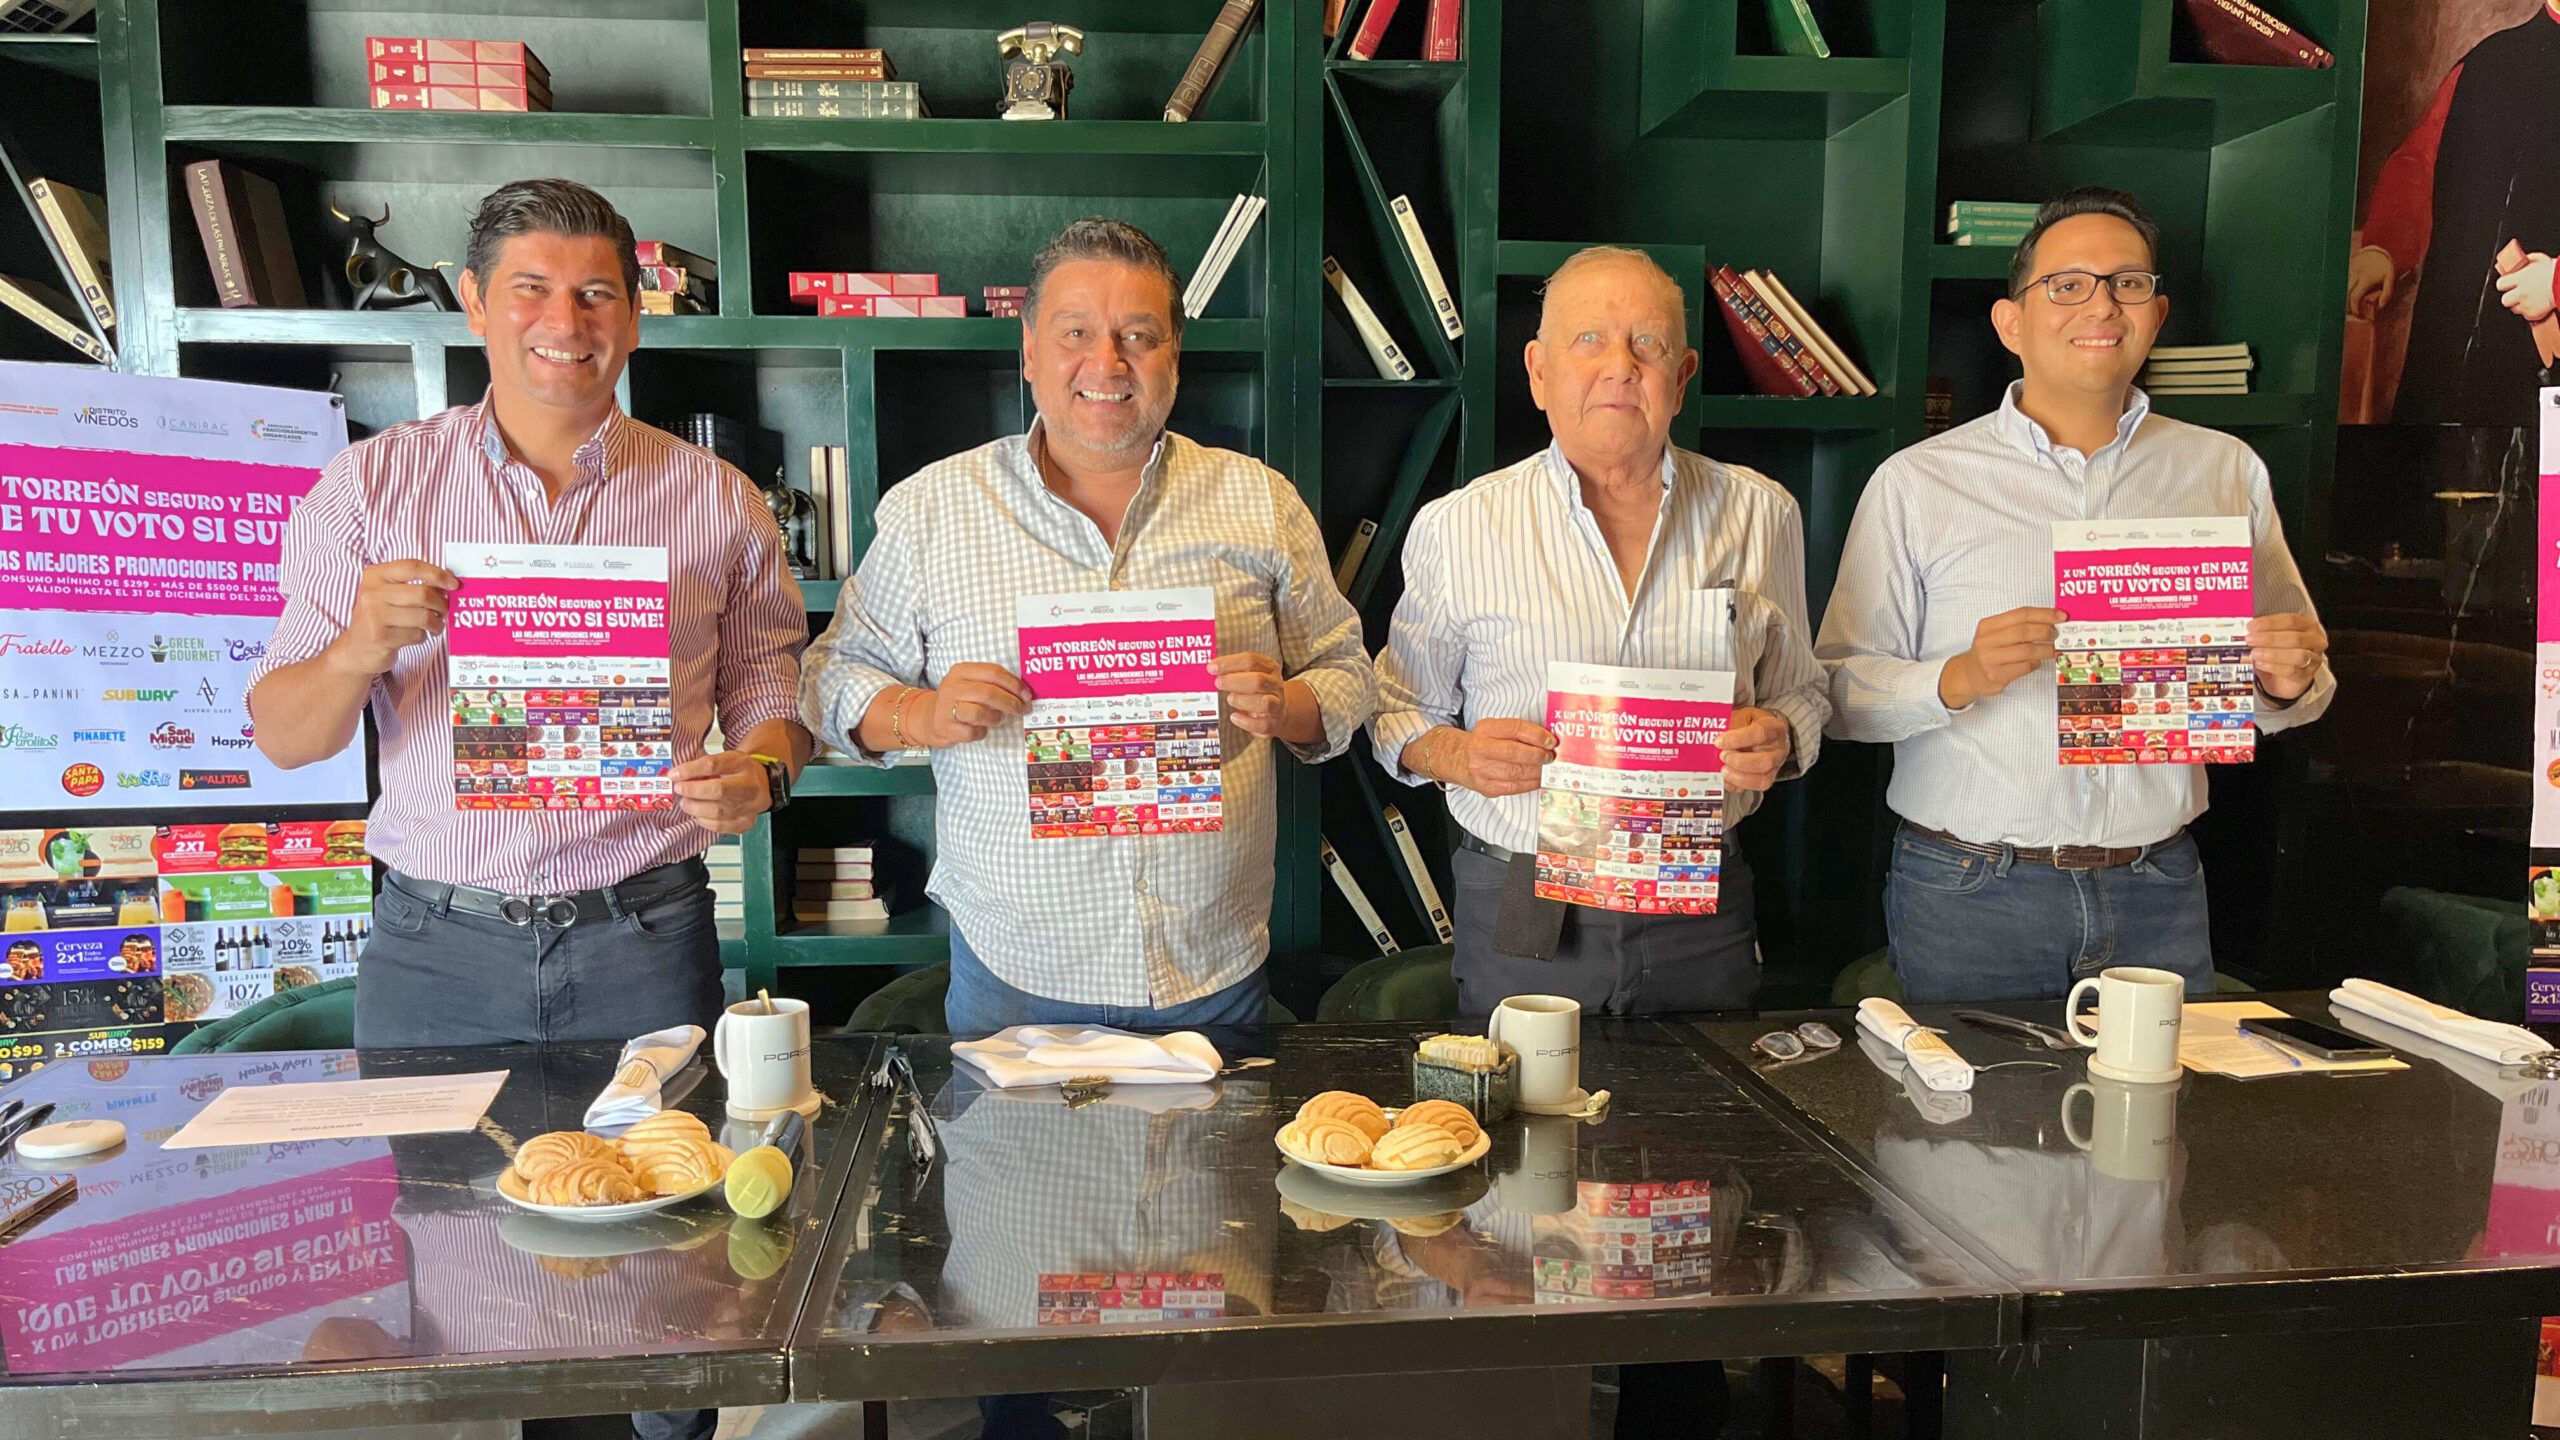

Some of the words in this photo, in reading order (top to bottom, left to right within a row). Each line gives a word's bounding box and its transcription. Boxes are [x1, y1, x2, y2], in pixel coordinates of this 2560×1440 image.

[813, 279, 827, 288] 2
[2, 475, 140, 506] TORREÓN
[144, 490, 225, 512] SEGURO
[228, 496, 243, 513] Y
[246, 492, 283, 515] EN
[31, 505, 81, 535] TU
[88, 509, 185, 541] VOTO
[192, 516, 228, 544] SI
[233, 518, 288, 546] SU
[0, 550, 20, 571] AS
[26, 551, 111, 575] MEJORES
[115, 555, 238, 581] PROMOCIONES
[2063, 569, 2071, 578] X
[2072, 569, 2086, 578] UN
[2088, 562, 2150, 578] TORREÓN
[2152, 566, 2190, 575] SEGURO
[2192, 565, 2199, 574] Y
[2201, 562, 2220, 574] EN
[2222, 561, 2248, 573] PAZ
[104, 579, 120, 588] DE
[123, 579, 150, 589] $299
[188, 582, 203, 591] DE
[206, 582, 240, 593] $5000
[243, 585, 258, 593] EN
[2060, 580, 2097, 596] ¡QUE
[2100, 579, 2123, 594] TU
[2126, 578, 2171, 593] VOTO
[2174, 577, 2190, 592] SI
[2194, 575, 2249, 591] SUME!
[27, 584, 71, 594] VÁLIDO
[74, 587, 112, 596] HASTA
[115, 589, 129, 597] EL
[131, 590, 143, 598] 31
[146, 590, 162, 599] DE
[165, 591, 226, 601] DICIEMBRE
[229, 593, 251, 602] DEL
[253, 594, 279, 603] 2024
[458, 597, 469, 607] X
[469, 598, 485, 608] UN
[486, 592, 558, 610] TORREÓN
[560, 599, 602, 610] SEGURO
[604, 599, 612, 610] Y
[614, 597, 635, 610] EN
[636, 597, 665, 611] PAZ
[454, 610, 497, 628] ¡QUE
[501, 611, 527, 627] TU
[531, 612, 582, 628] VOTO
[585, 612, 603, 628] SI
[606, 612, 665, 629] SUME!
[0, 633, 76, 657] Fratello
[168, 637, 205, 650] GREEN
[1028, 646, 1036, 655] X
[1037, 645, 1051, 655] UN
[1053, 637, 1116, 654] TORREÓN
[1117, 641, 1156, 651] SEGURO
[1157, 640, 1165, 649] Y
[1166, 637, 1185, 649] EN
[1186, 634, 1212, 647] PAZ
[83, 646, 145, 659] MEZZO
[168, 649, 222, 662] GOURMET
[1025, 657, 1064, 674] ¡QUE
[1067, 655, 1090, 670] TU
[1093, 653, 1138, 669] VOTO
[1140, 652, 1157, 667] SI
[1159, 649, 1212, 665] SUME!
[102, 688, 178, 702] SUBWAY
[1555, 710, 1562, 718] X
[1578, 709, 1637, 726] TORREÓN
[1638, 717, 1674, 728] SEGURO
[1676, 719, 1682, 728] Y
[1684, 717, 1700, 729] EN
[1702, 717, 1727, 729] PAZ
[73, 731, 126, 742] PINABETE
[167, 725, 191, 736] San
[1587, 725, 1608, 740] TU
[1613, 728, 1656, 744] VOTO
[1659, 730, 1673, 745] SI
[150, 732, 195, 745] Miguel
[211, 735, 254, 749] Happy
[65, 767, 99, 780] SANTA
[207, 774, 247, 785] ALITAS
[70, 775, 99, 788] PAPA
[55, 941, 104, 951] Cerveza
[170, 944, 204, 958] 10%
[280, 938, 312, 951] 10%
[56, 951, 84, 964] 2x1
[229, 983, 263, 1000] 10%
[2530, 993, 2556, 1005] 2x1
[88, 1029, 132, 1040] SUBWAY
[12, 1044, 43, 1059] $99
[69, 1037, 133, 1052] COMBO
[132, 1037, 166, 1052] $159
